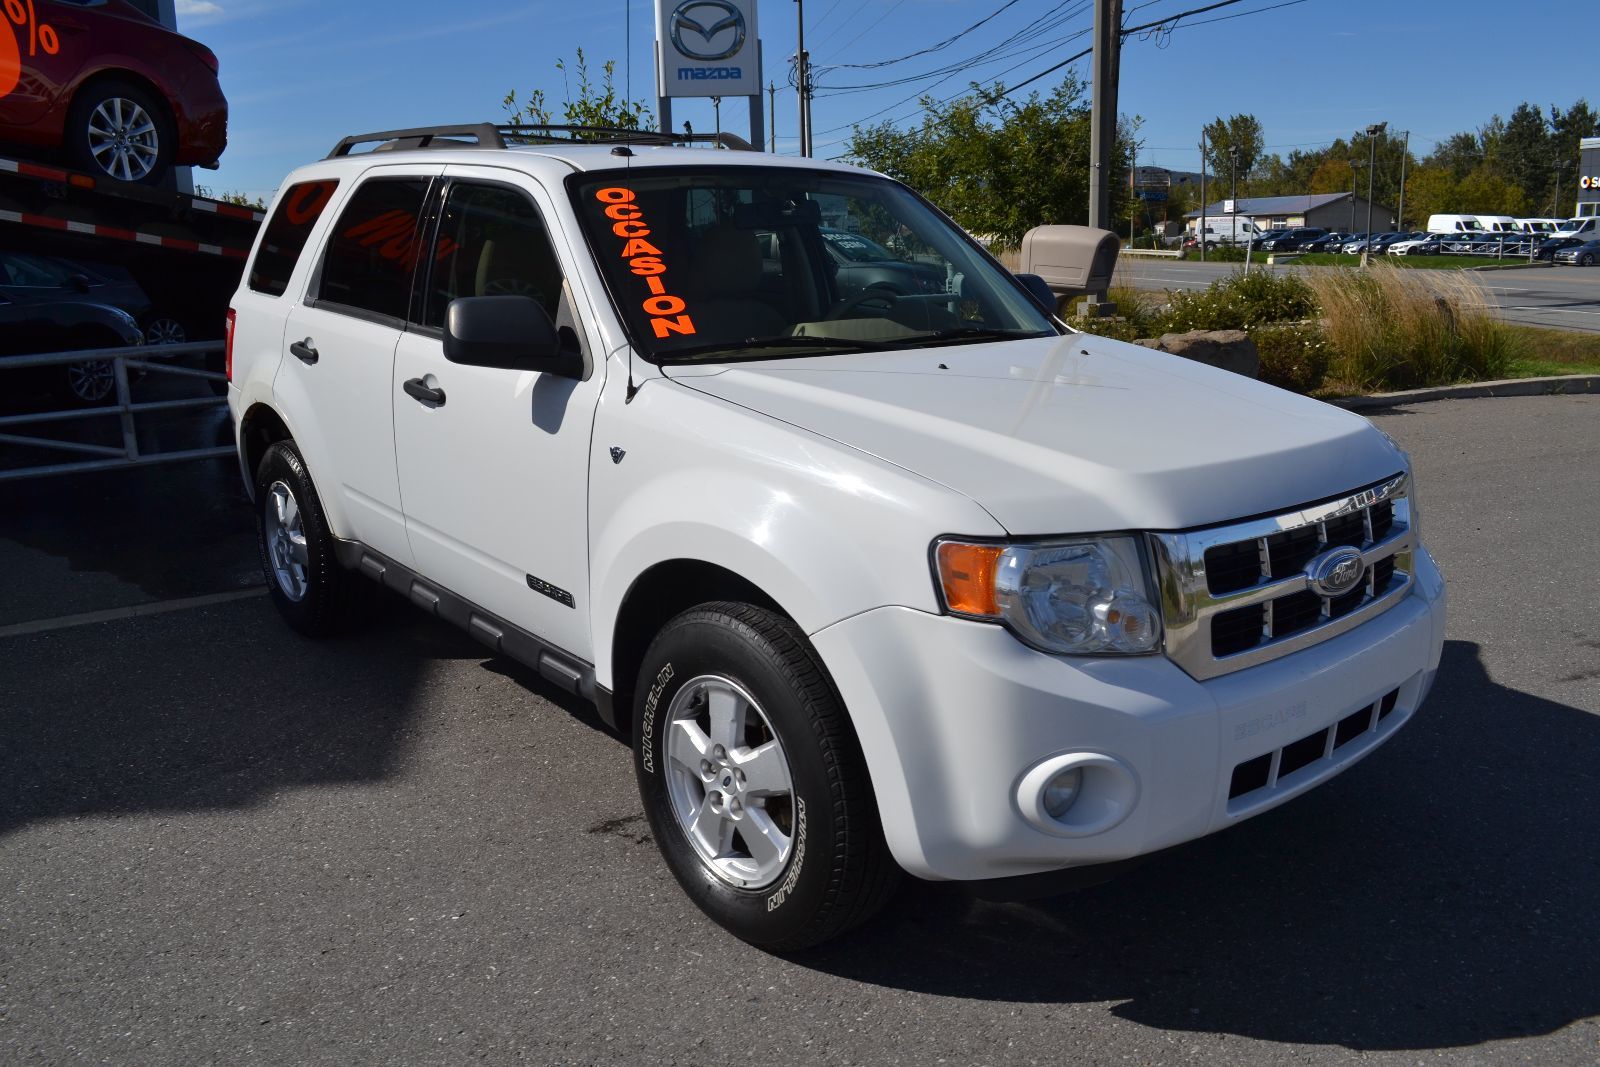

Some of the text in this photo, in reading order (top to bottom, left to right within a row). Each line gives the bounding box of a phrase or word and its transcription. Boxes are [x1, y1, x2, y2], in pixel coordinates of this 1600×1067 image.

[595, 187, 696, 339] OCCASION
[1331, 560, 1359, 585] Ford
[642, 662, 675, 774] MICHELIN
[767, 795, 807, 912] MICHELIN
